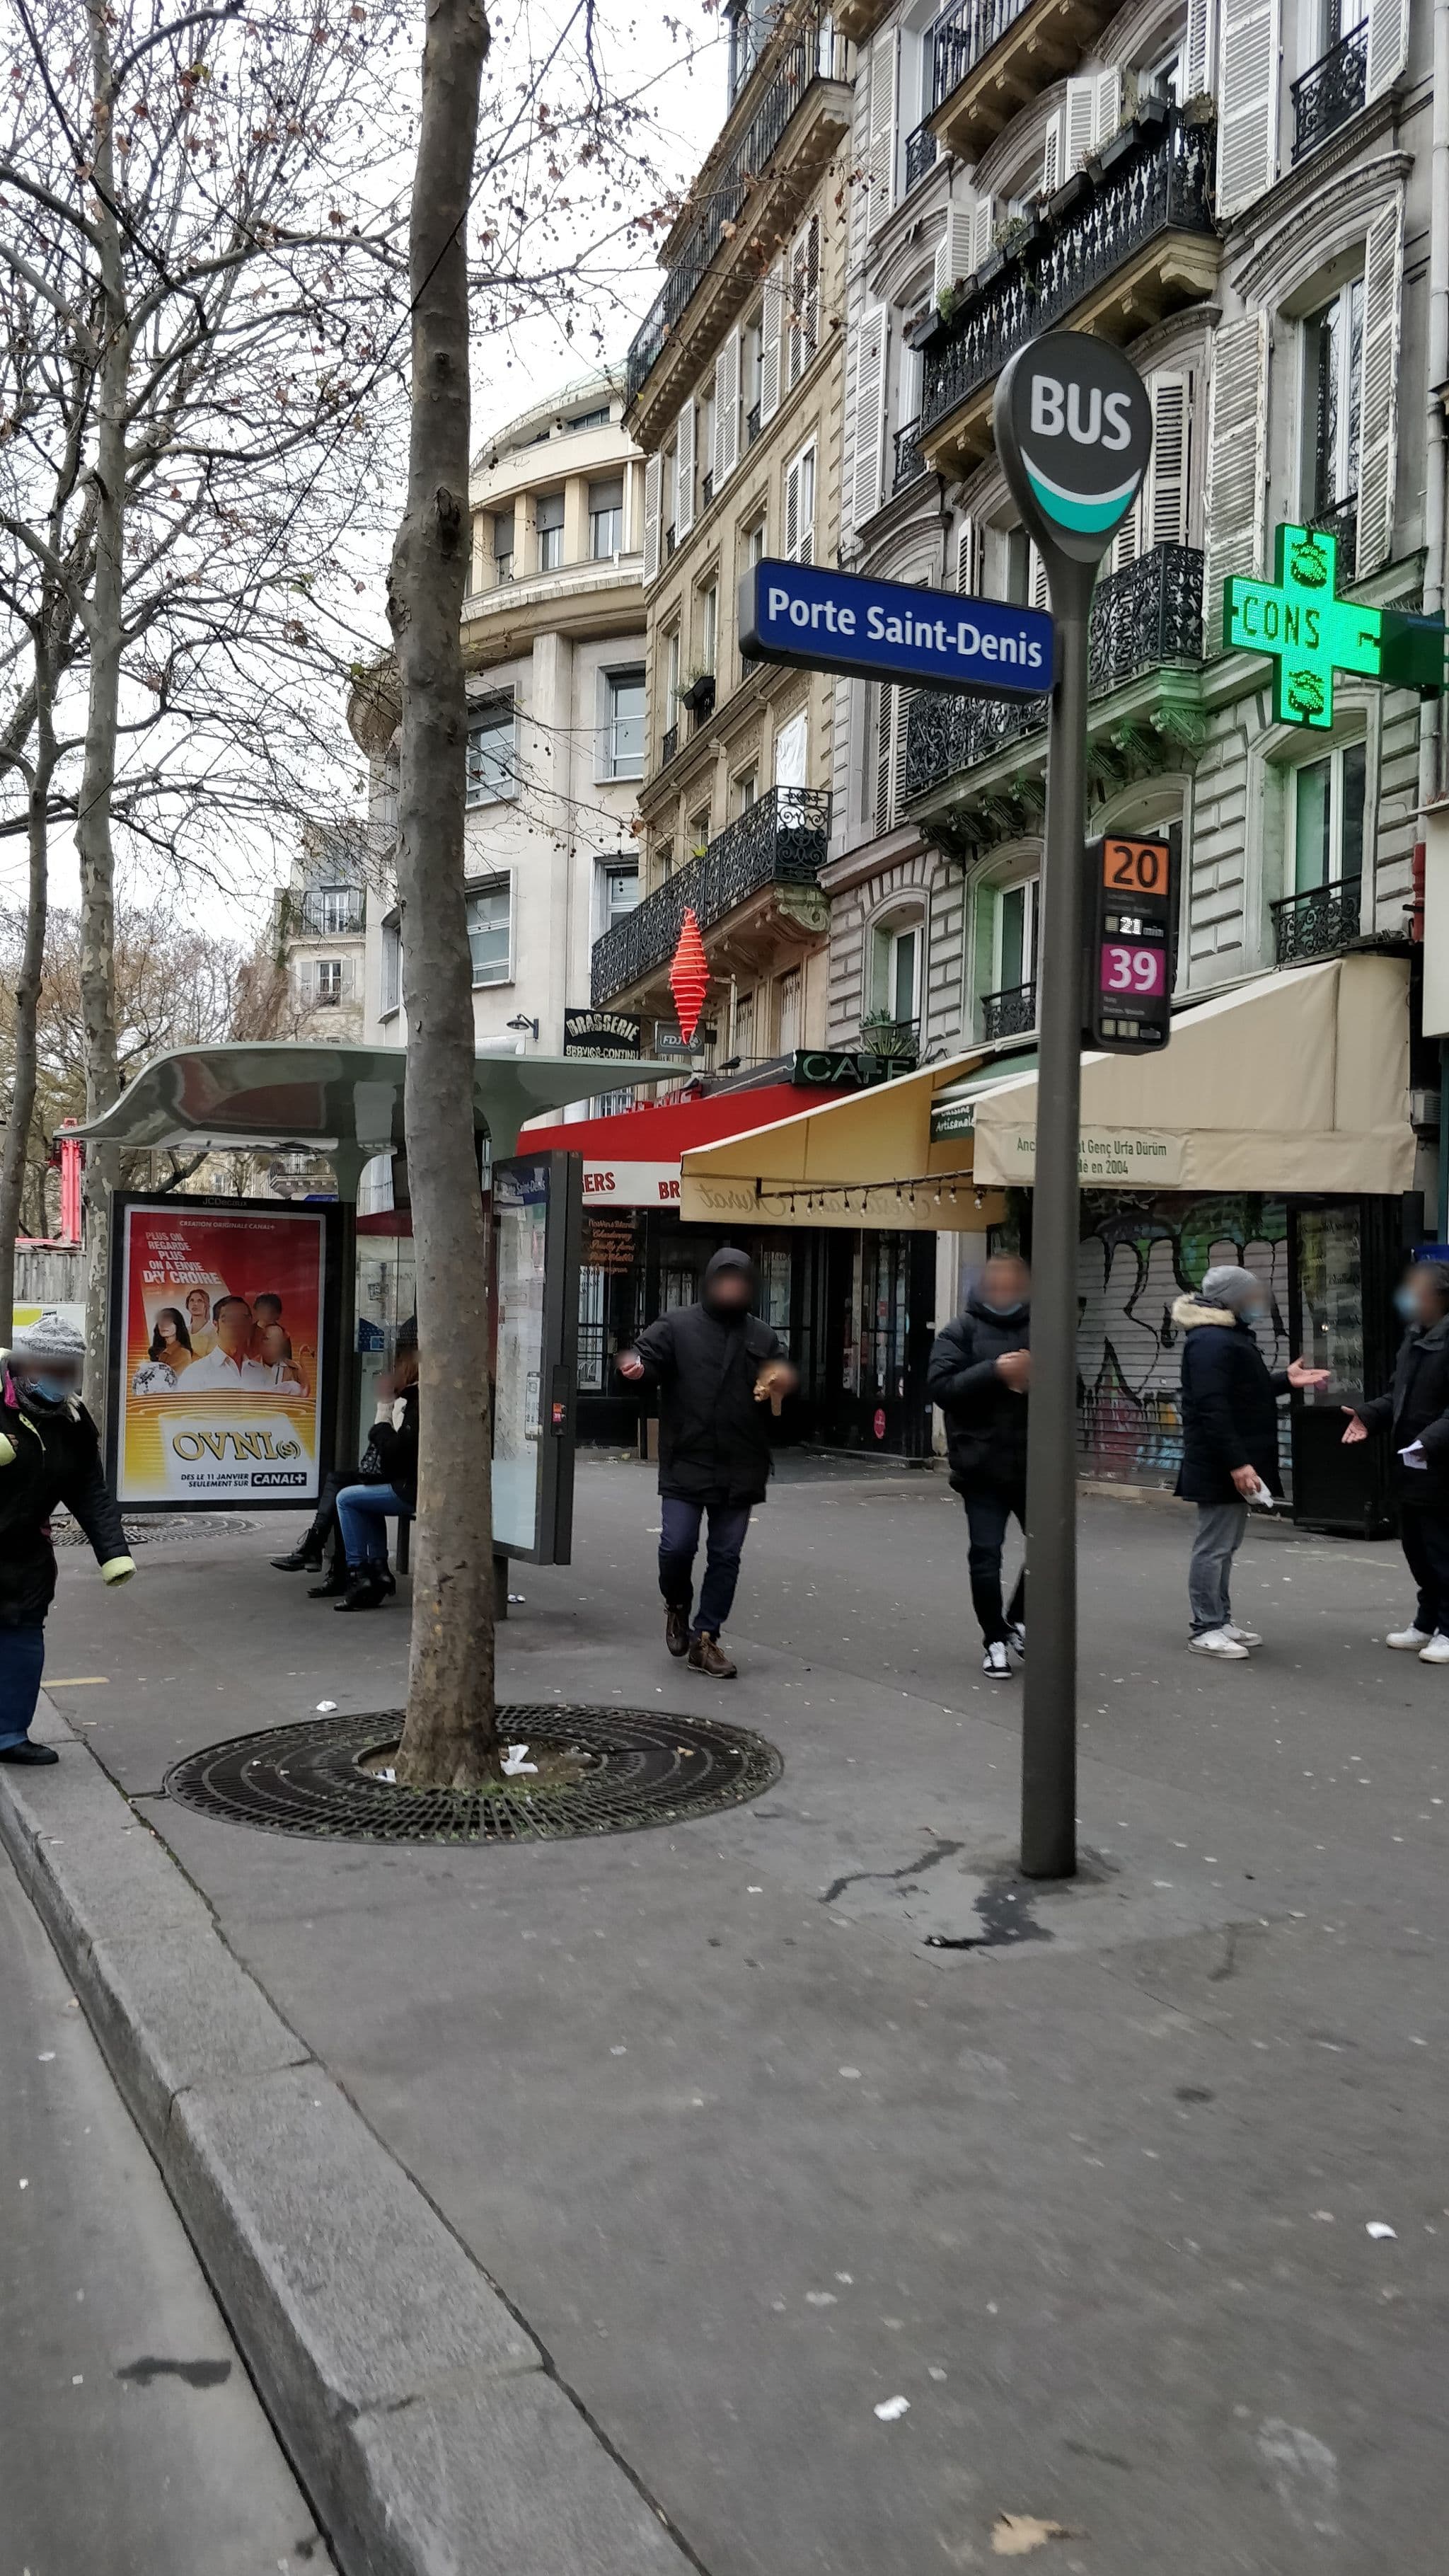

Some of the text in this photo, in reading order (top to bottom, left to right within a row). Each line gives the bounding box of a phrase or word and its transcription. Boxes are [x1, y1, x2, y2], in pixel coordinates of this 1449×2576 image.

[1029, 374, 1131, 450] BUS
[768, 587, 1042, 667] Porte Saint-Denis
[1243, 596, 1320, 650] CONS
[1113, 846, 1158, 888] 20
[1108, 948, 1158, 991] 39
[566, 1013, 640, 1042] BRASSERIE
[663, 1035, 683, 1045] FDJ
[1087, 1139, 1112, 1158] Genç
[1114, 1140, 1133, 1155] Urfa
[1136, 1141, 1167, 1156] Dürüm
[1091, 1163, 1103, 1173] en
[1105, 1160, 1128, 1175] 2004
[202, 1197, 248, 1207] JCDecaux
[145, 1231, 185, 1241] PLUS ON
[148, 1241, 192, 1251] REGARDE
[158, 1250, 185, 1260] PLUS
[149, 1260, 204, 1271] ON A ENVIE
[170, 1271, 222, 1284] CROIRE
[253, 1473, 306, 1484] CANAL+
